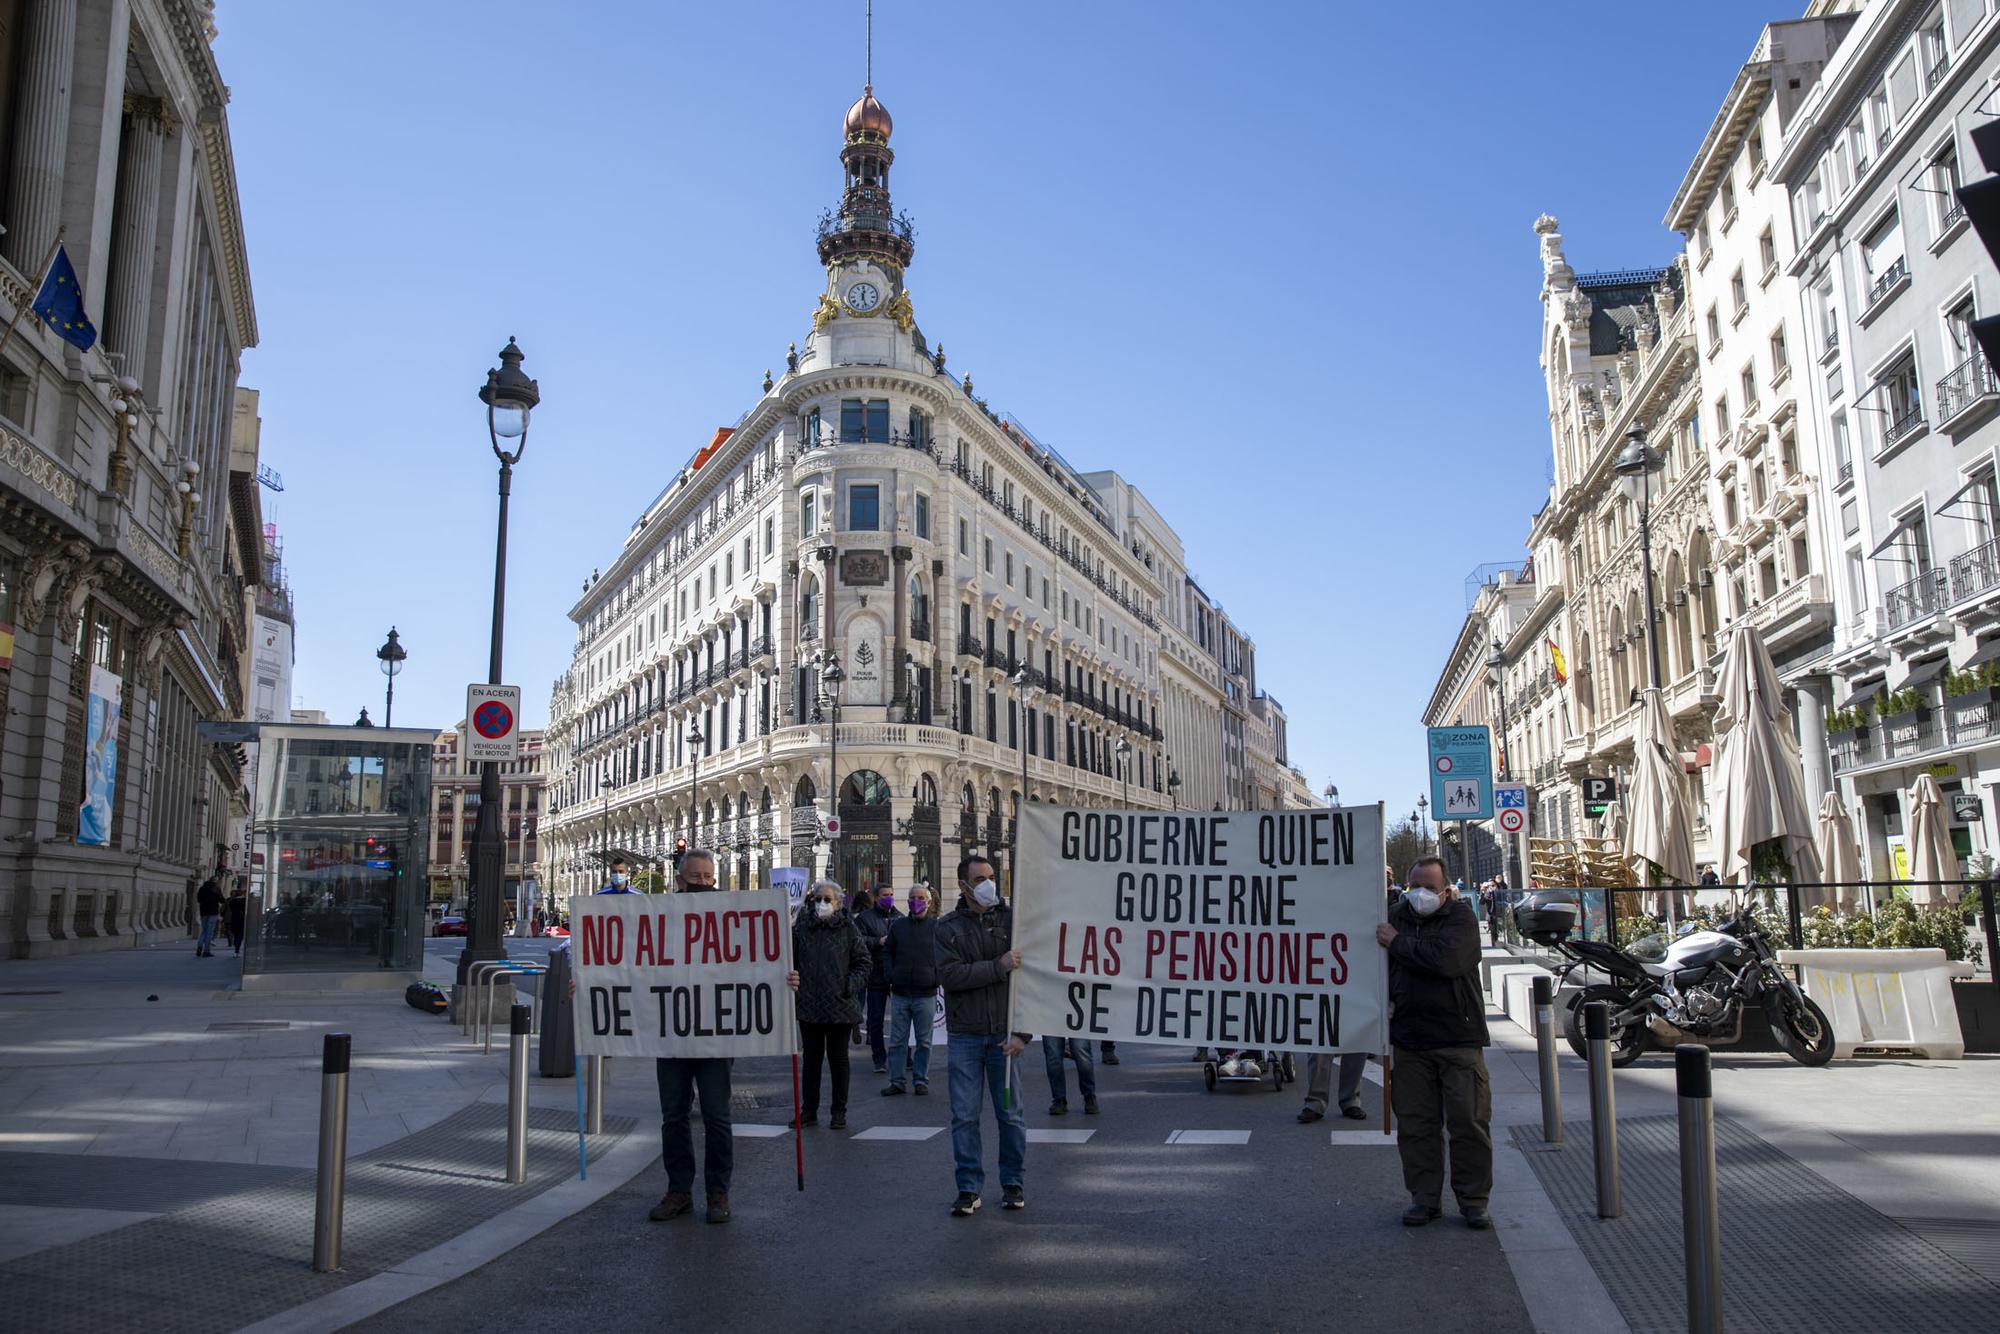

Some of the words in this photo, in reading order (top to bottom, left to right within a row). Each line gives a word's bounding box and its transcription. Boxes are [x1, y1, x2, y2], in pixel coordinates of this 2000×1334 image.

[486, 690, 515, 698] ACERA
[1451, 733, 1486, 741] ZONA
[1591, 780, 1606, 798] P
[1956, 797, 1977, 805] ATM
[1061, 811, 1229, 866] GOBIERNE
[1258, 812, 1354, 869] QUIEN
[1507, 816, 1517, 824] 10
[1115, 872, 1297, 926] GOBIERNE
[582, 915, 624, 966] NO
[635, 914, 674, 966] AL
[684, 909, 781, 965] PACTO
[1057, 922, 1122, 977] LAS
[1145, 929, 1348, 986] PENSIONES
[590, 986, 633, 1036] DE
[650, 982, 774, 1037] TOLEDO
[1065, 981, 1112, 1034] SE
[1135, 986, 1341, 1047] DEFIENDEN
